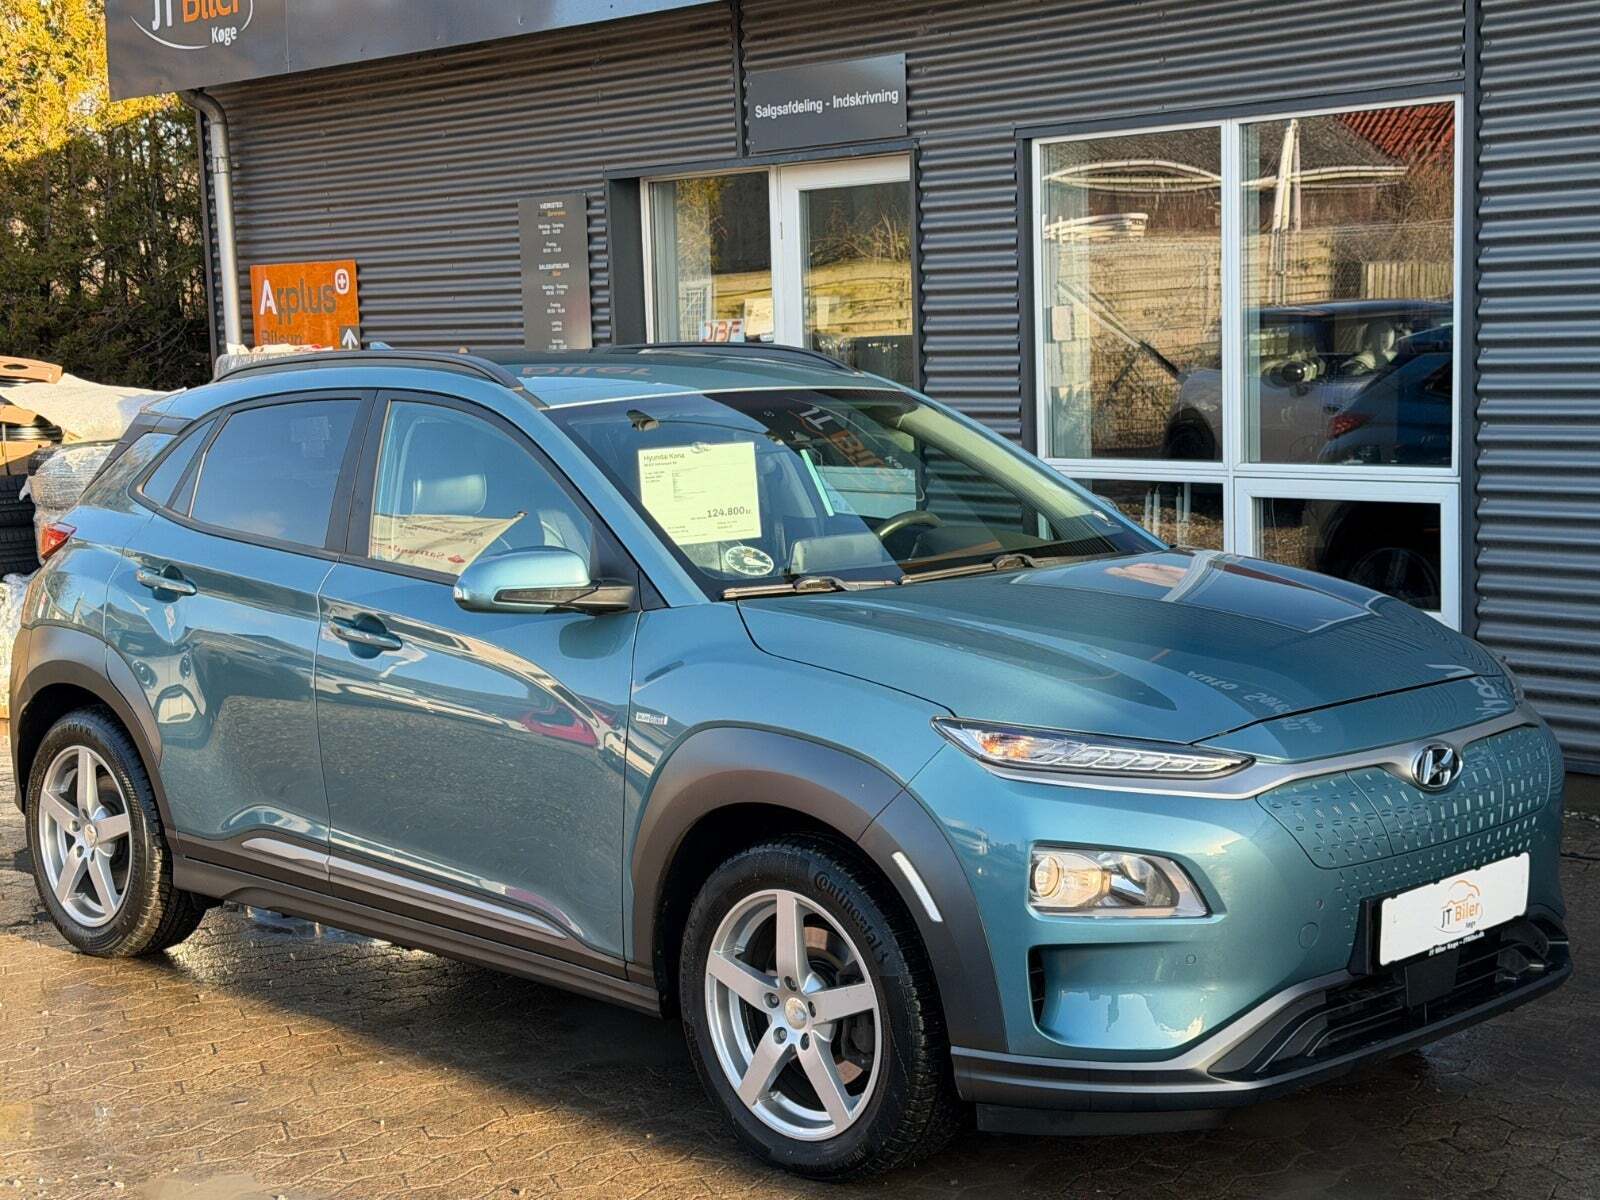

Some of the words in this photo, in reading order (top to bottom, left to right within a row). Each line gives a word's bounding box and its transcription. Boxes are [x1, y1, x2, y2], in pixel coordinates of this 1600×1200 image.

[211, 26, 237, 46] Køge
[755, 99, 823, 119] Salgsafdeling
[833, 89, 898, 108] Indskrivning
[706, 506, 745, 518] 124.800
[814, 871, 883, 951] Continental
[1456, 903, 1480, 921] Biler
